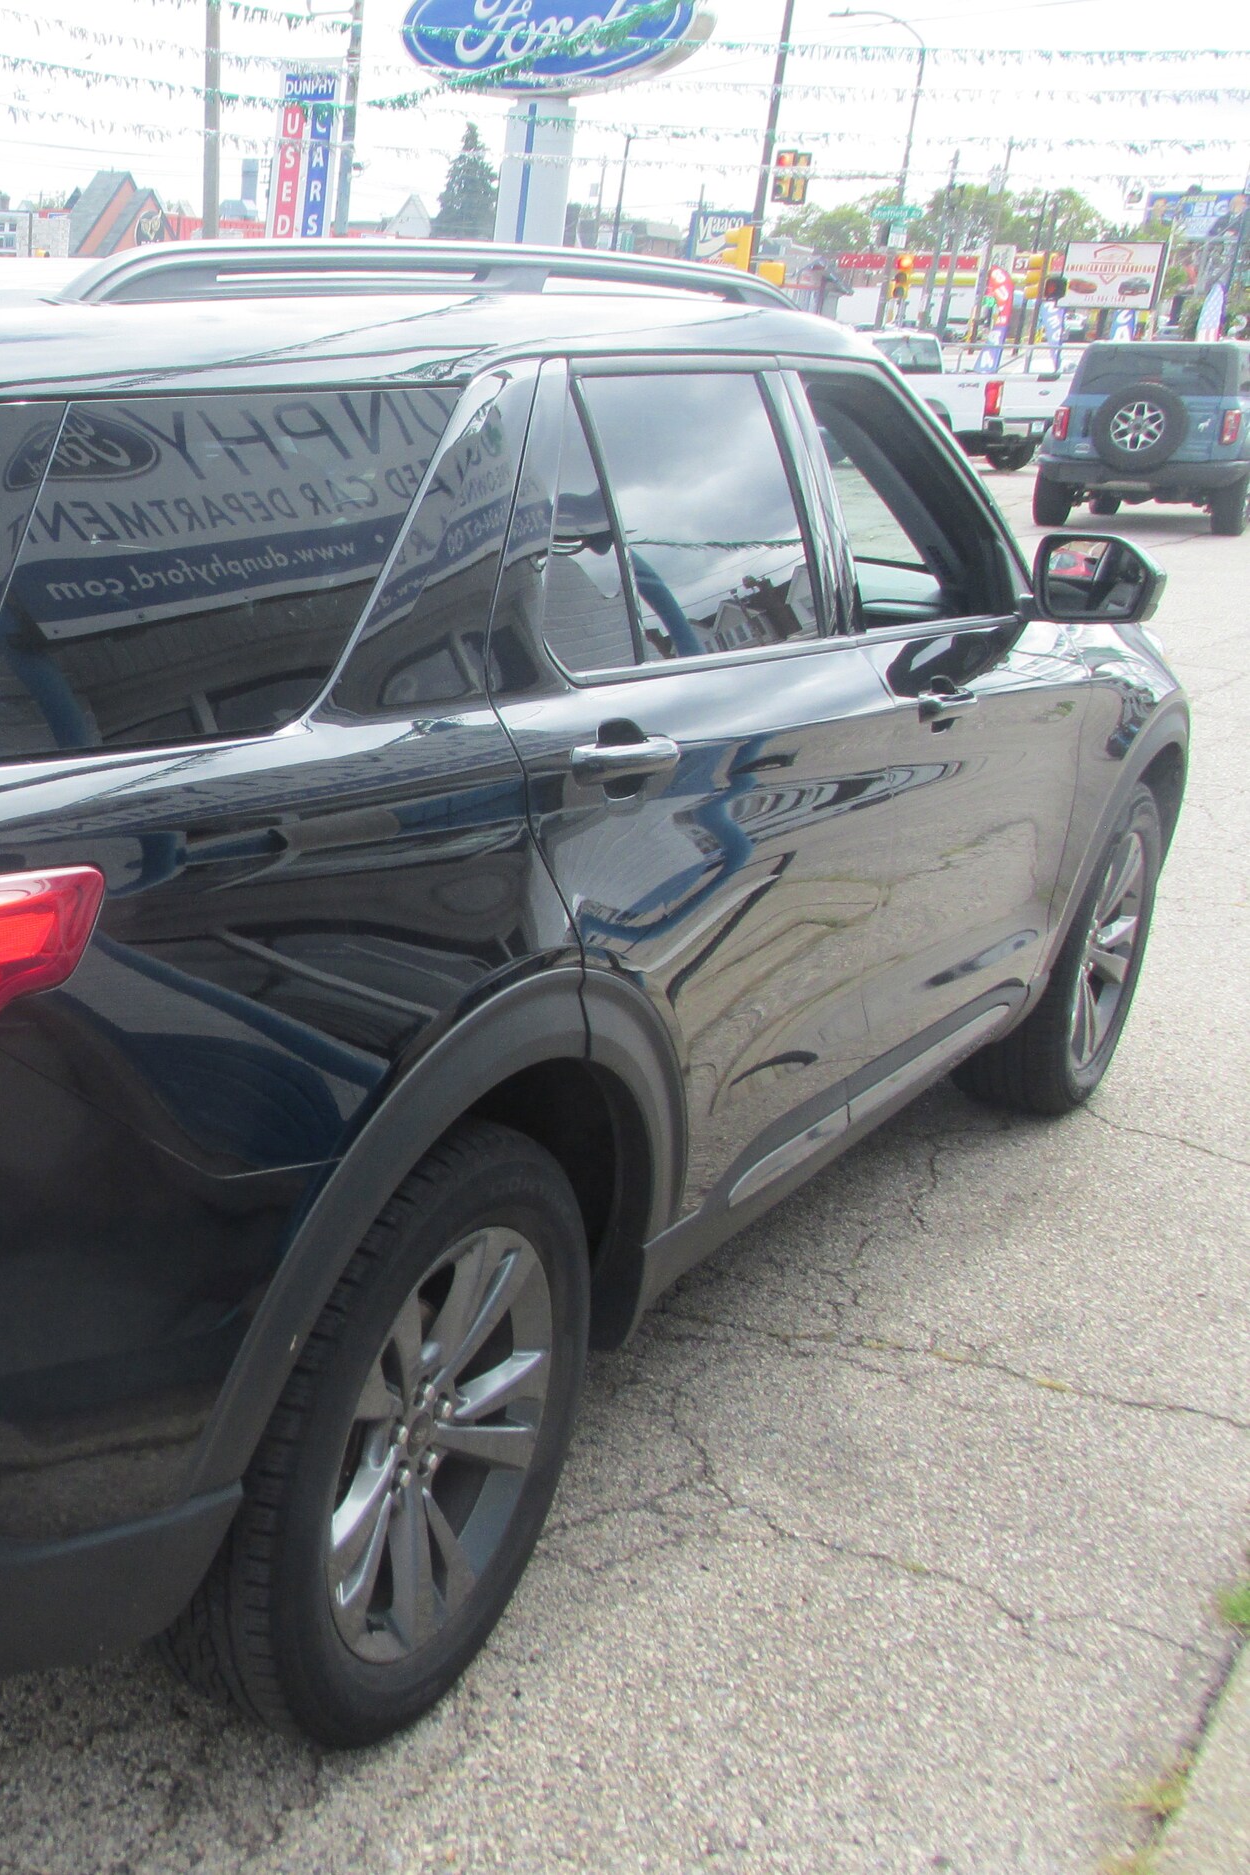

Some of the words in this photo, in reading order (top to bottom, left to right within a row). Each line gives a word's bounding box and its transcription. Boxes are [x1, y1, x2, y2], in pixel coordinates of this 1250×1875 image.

[455, 0, 630, 63] Ford
[285, 79, 335, 95] DUNPHY
[275, 112, 300, 236] USED
[698, 216, 745, 241] Maaco
